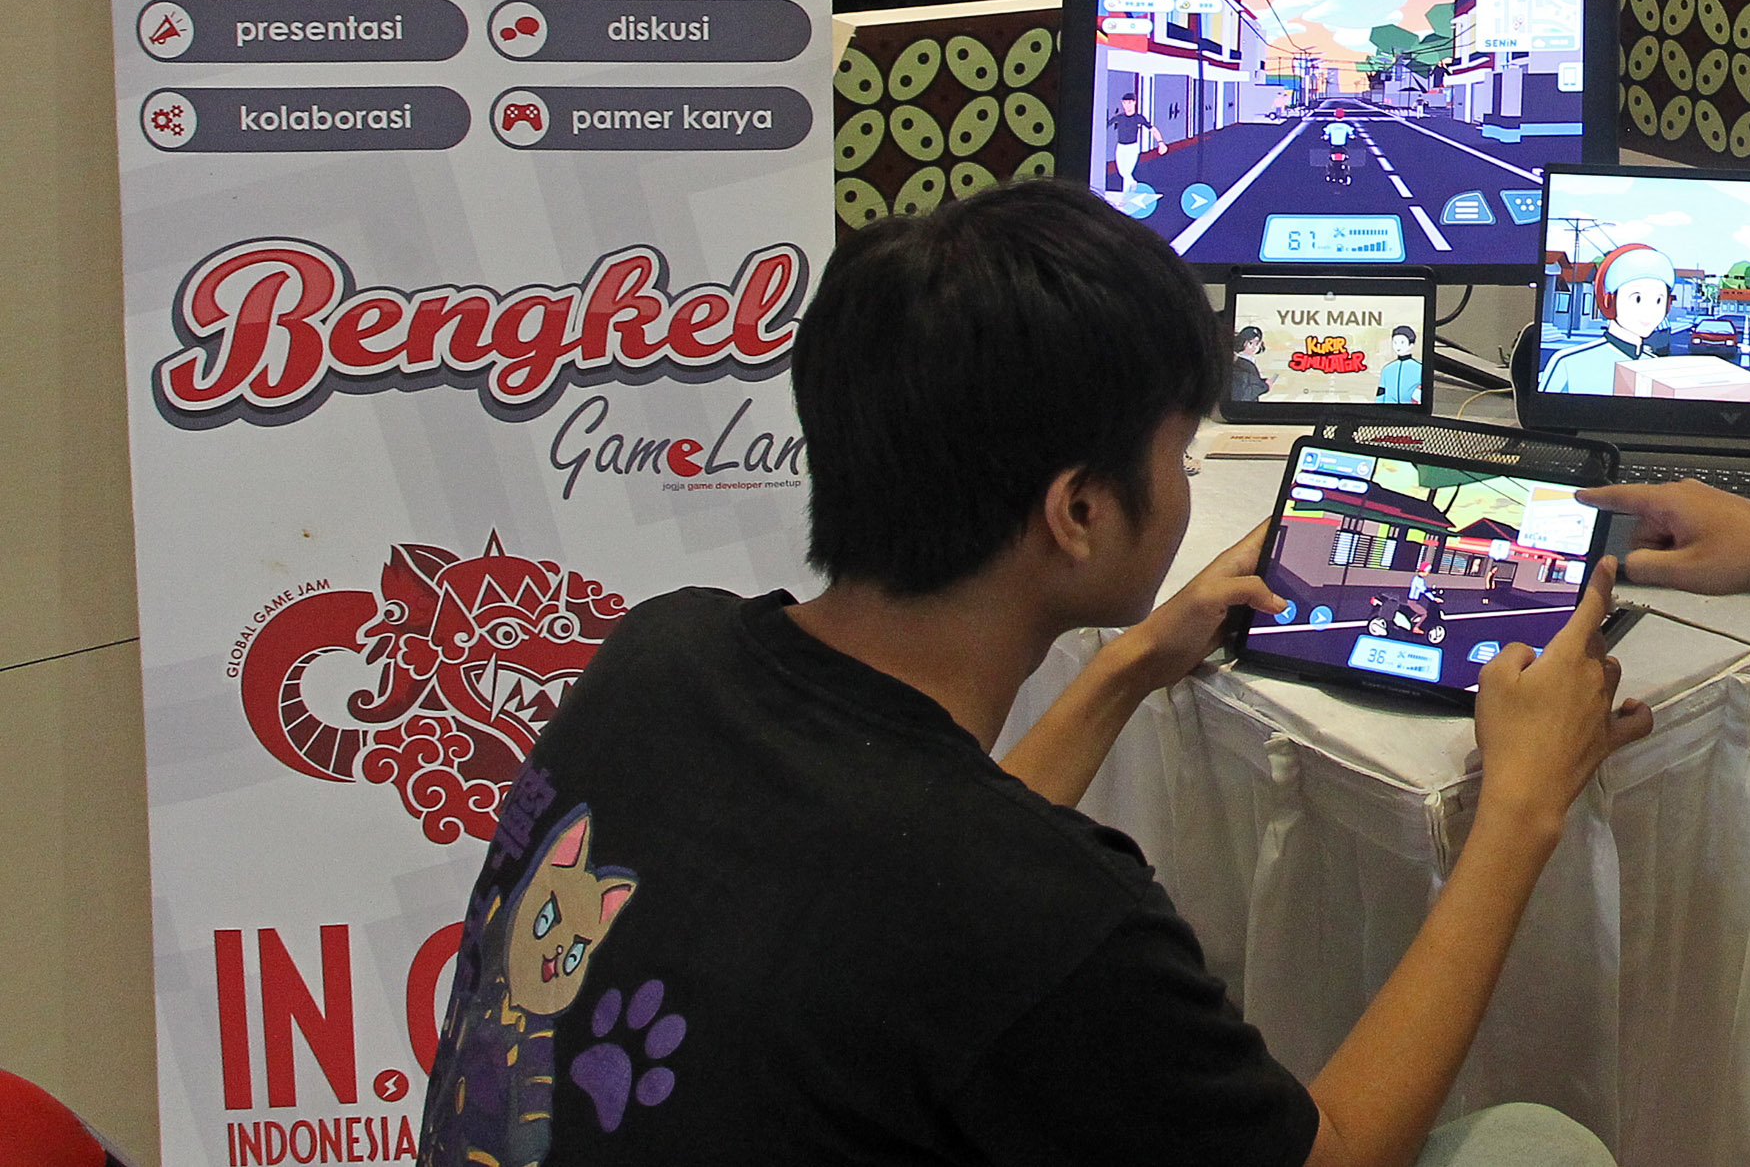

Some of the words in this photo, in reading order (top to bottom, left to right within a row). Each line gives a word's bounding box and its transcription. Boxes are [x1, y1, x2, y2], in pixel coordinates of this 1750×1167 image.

[235, 15, 404, 47] presentasi
[606, 14, 711, 43] diskusi
[239, 105, 413, 132] kolaborasi
[571, 108, 675, 136] pamer
[682, 105, 774, 136] karya
[160, 239, 802, 414] Bengkel
[1277, 309, 1320, 326] YUK
[1327, 310, 1382, 326] MAIN
[550, 395, 808, 500] GameLan
[662, 482, 685, 491] jogja
[687, 483, 713, 491] game
[715, 481, 763, 490] developer
[764, 479, 802, 489] meetup
[226, 625, 257, 678] GLOBAL
[253, 589, 294, 624] GAME
[297, 578, 331, 597] JAM
[226, 1114, 418, 1167] INDONESIA
